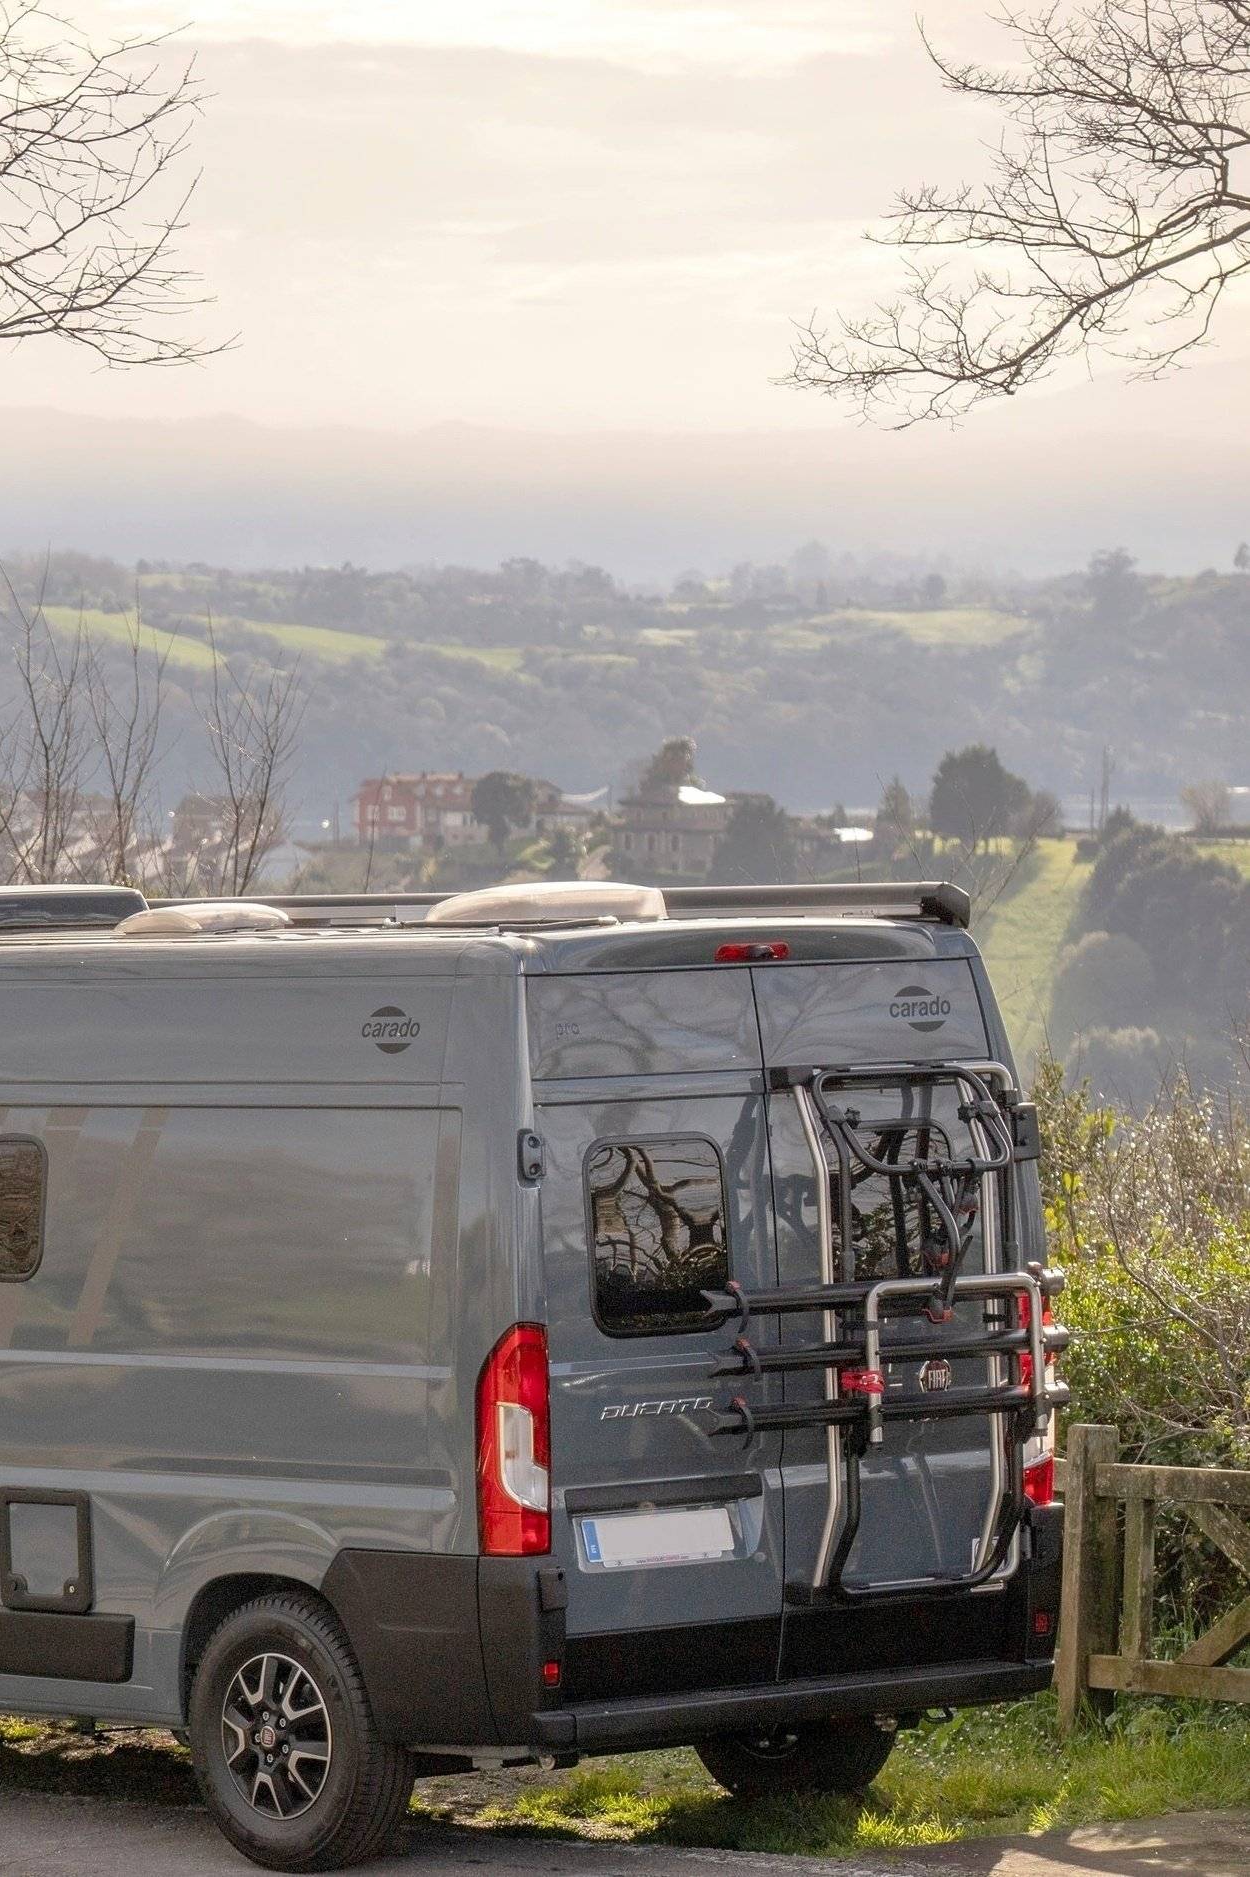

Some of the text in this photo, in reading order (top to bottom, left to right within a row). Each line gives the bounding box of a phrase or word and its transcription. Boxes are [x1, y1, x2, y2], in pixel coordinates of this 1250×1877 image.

[890, 995, 951, 1018] carado
[361, 1017, 421, 1038] carado
[929, 1369, 947, 1390] FIAT
[601, 1397, 714, 1420] DUCATO
